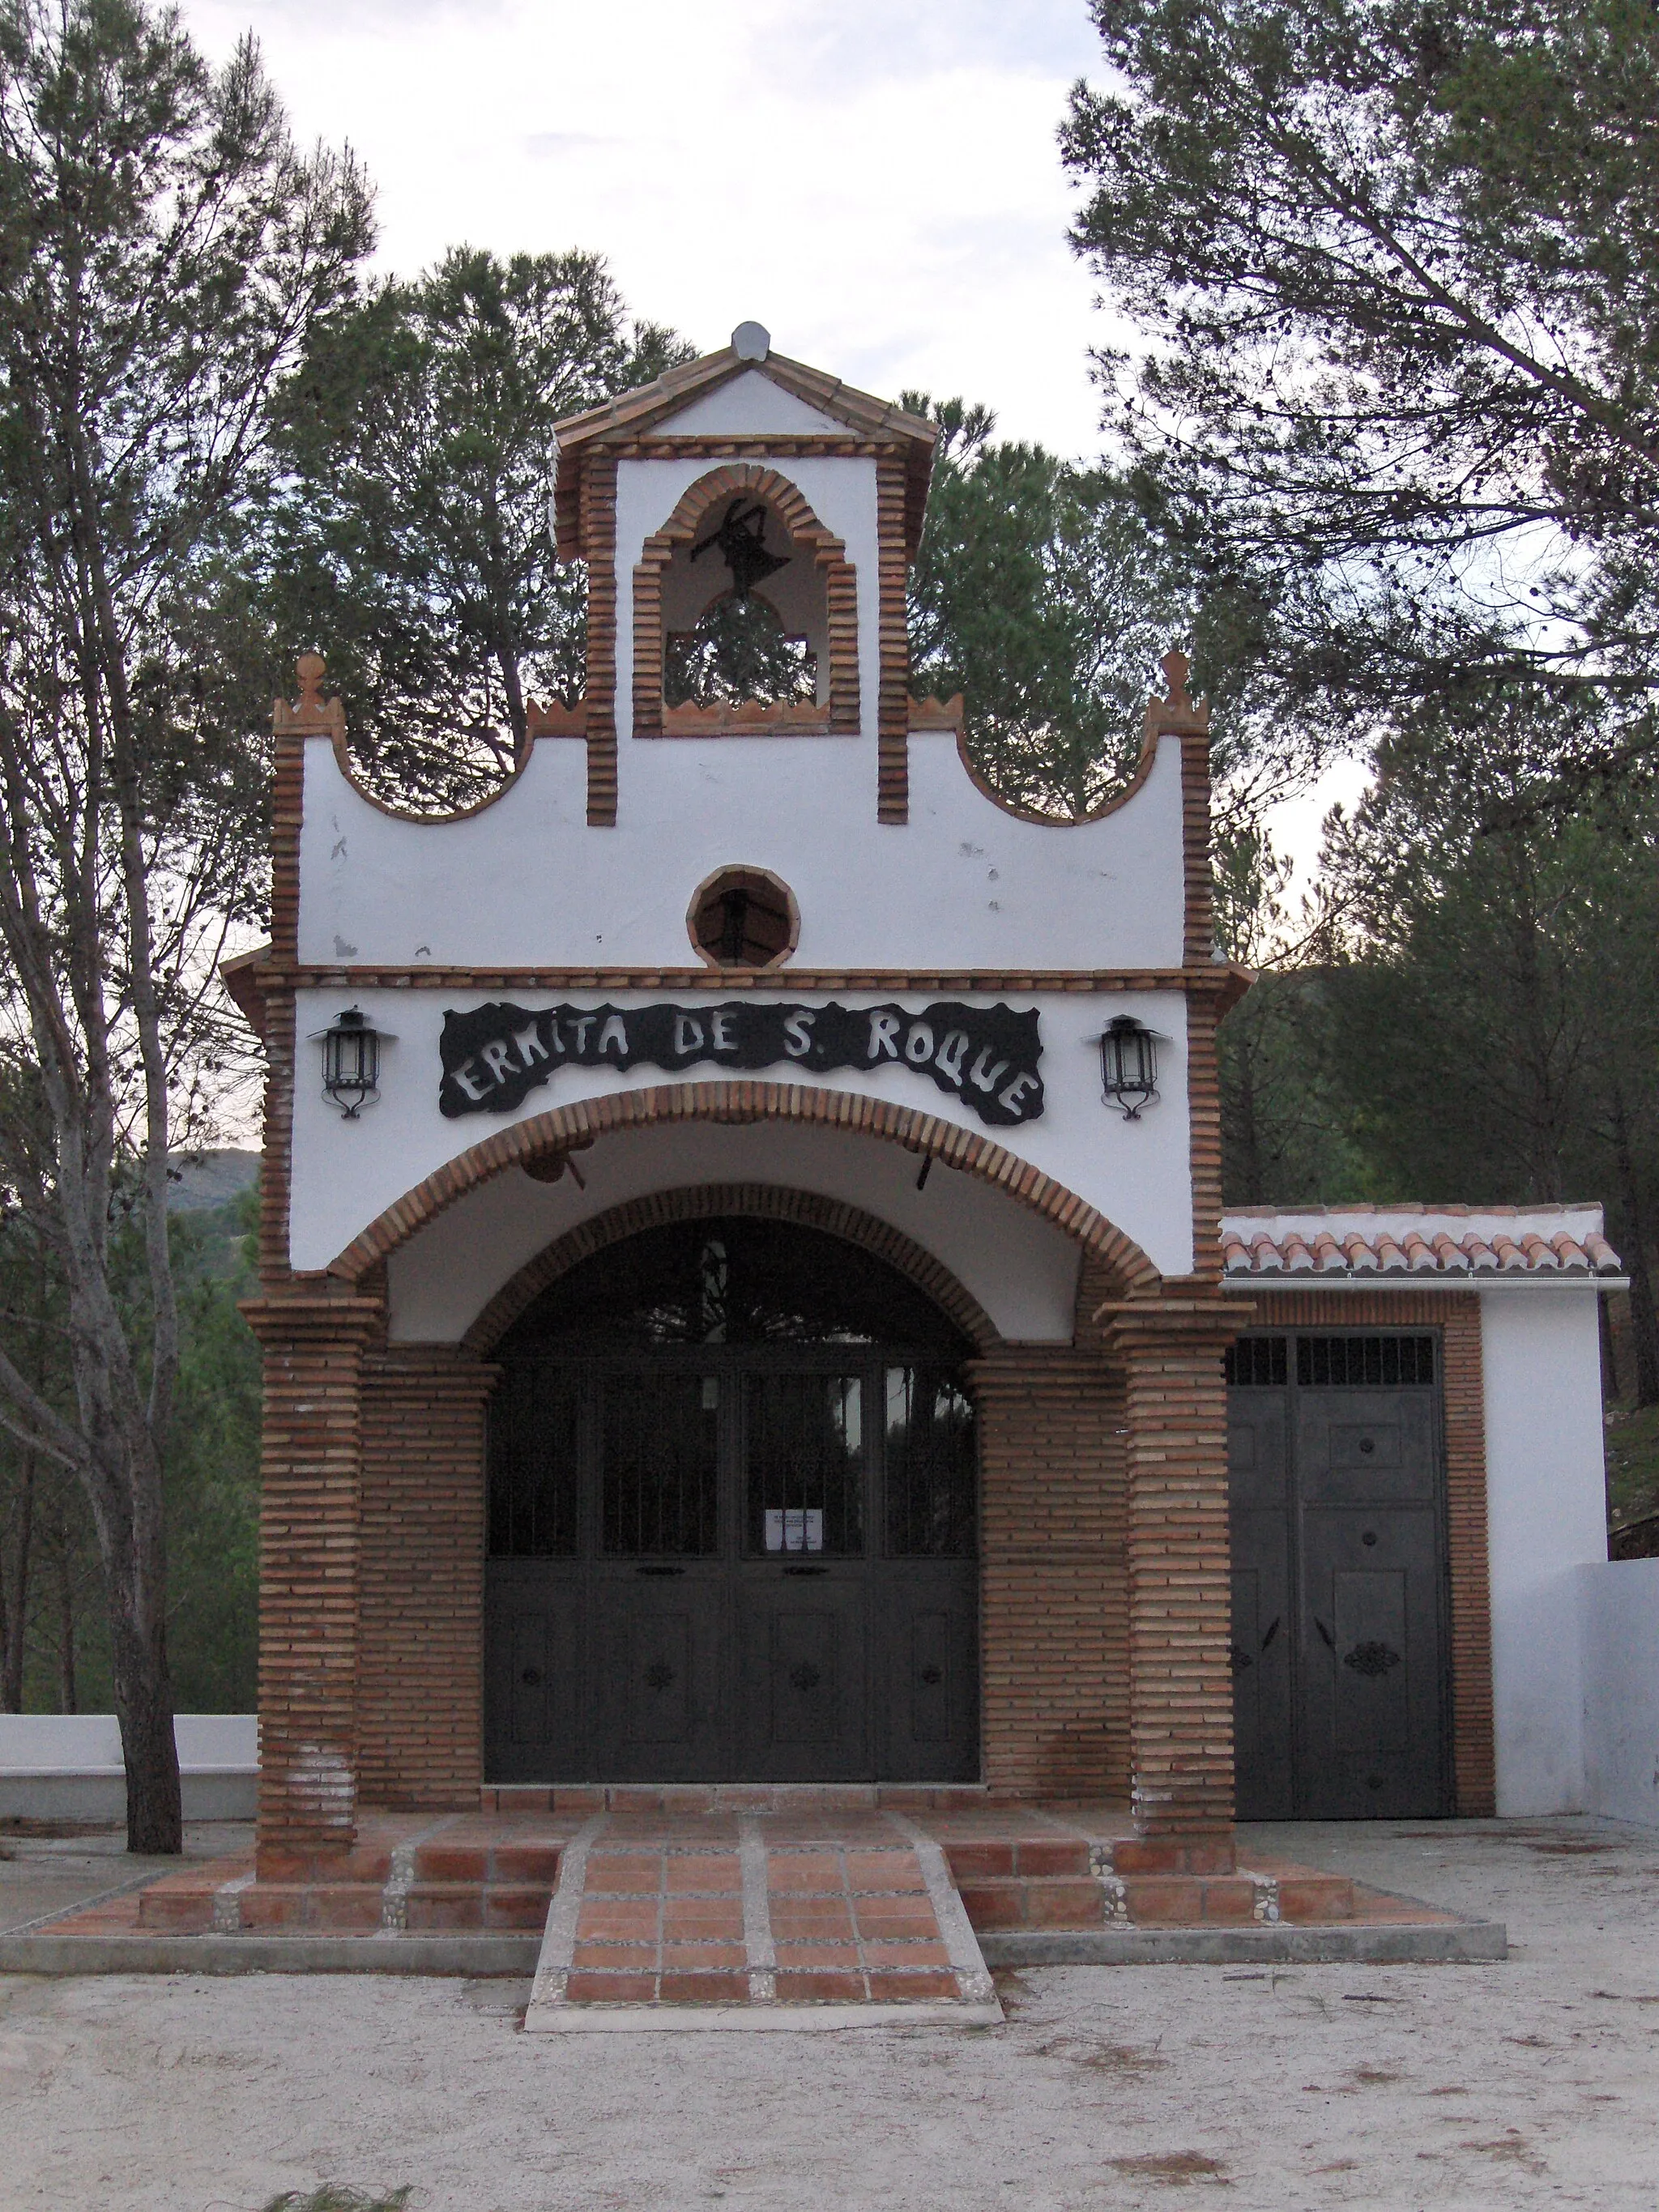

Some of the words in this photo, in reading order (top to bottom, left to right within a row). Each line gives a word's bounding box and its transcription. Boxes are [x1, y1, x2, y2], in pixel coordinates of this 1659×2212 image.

[674, 1011, 738, 1054] DE
[783, 1011, 825, 1056] S.
[868, 1010, 1039, 1116] ROQUE
